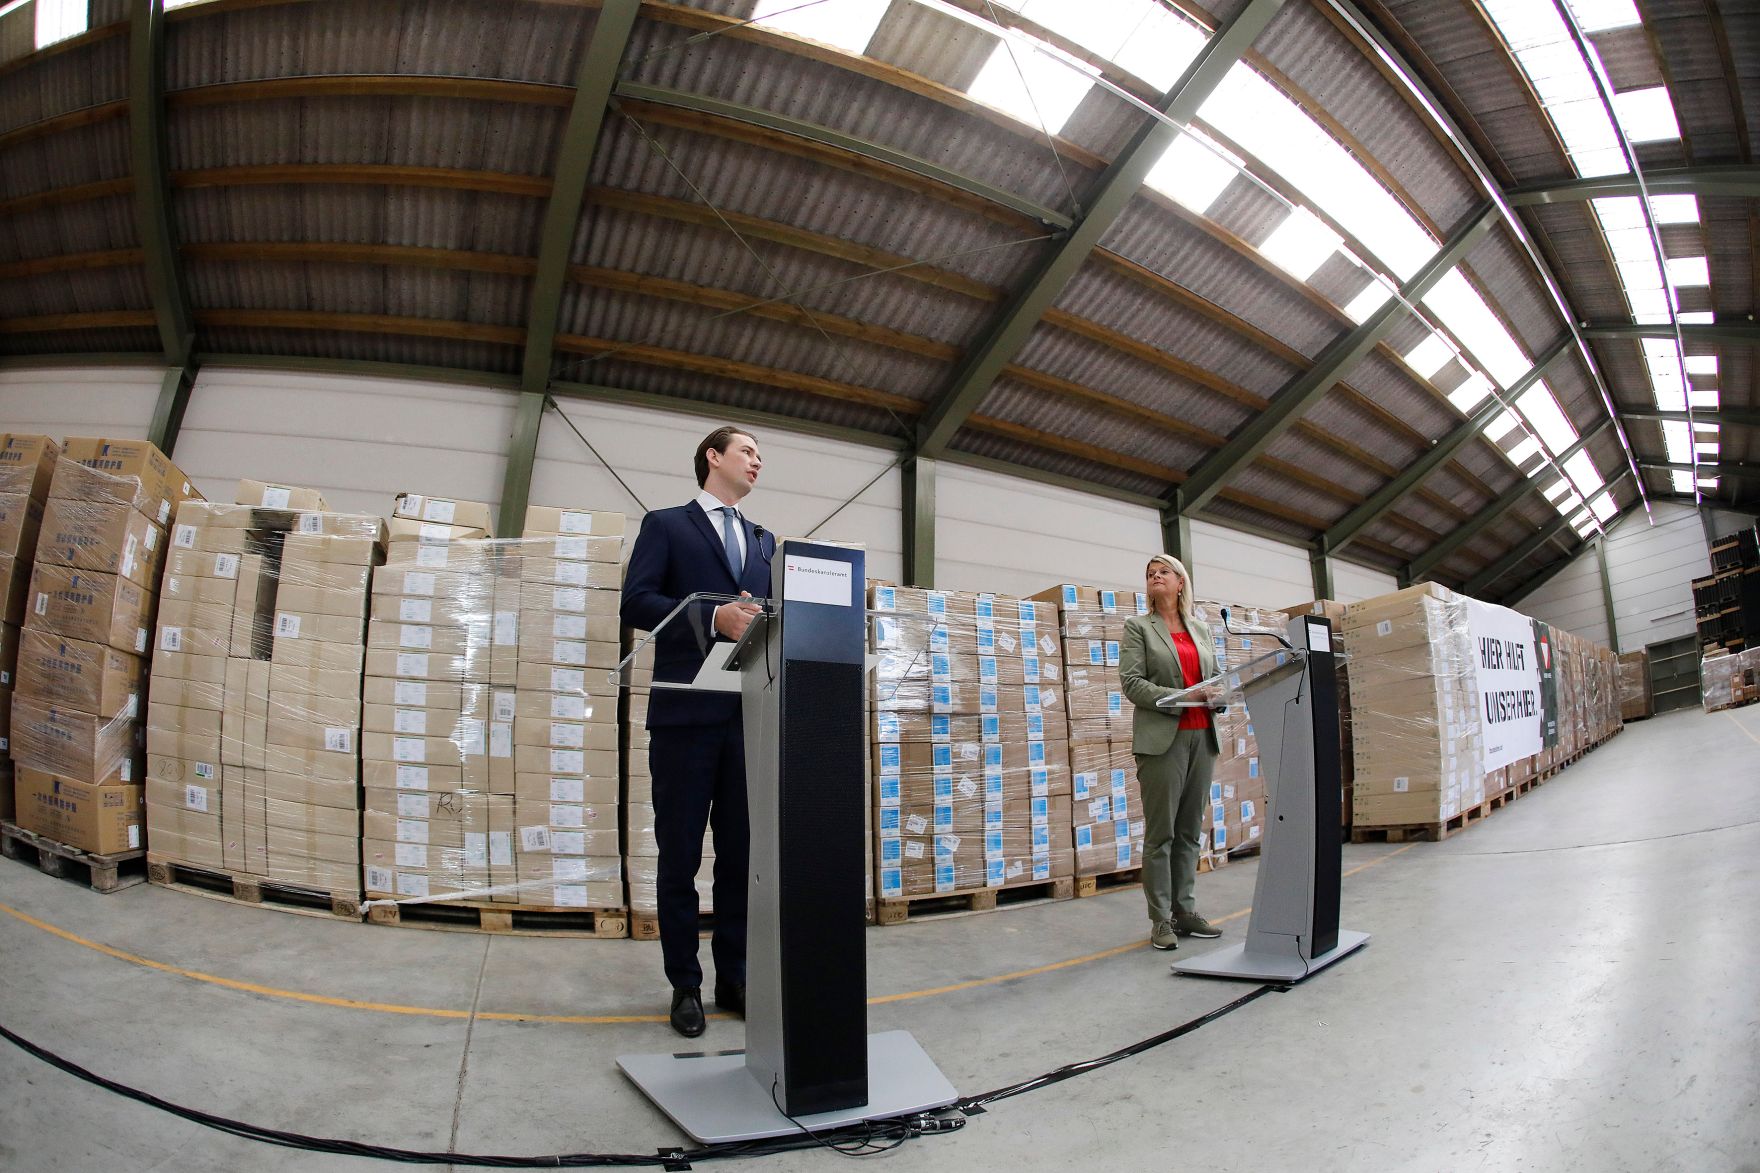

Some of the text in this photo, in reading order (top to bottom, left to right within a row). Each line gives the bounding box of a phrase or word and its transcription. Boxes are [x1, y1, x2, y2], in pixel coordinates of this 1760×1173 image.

[797, 566, 848, 578] Bundeskanzleramt
[1478, 636, 1504, 669] HIER
[1485, 690, 1516, 725] UNSER
